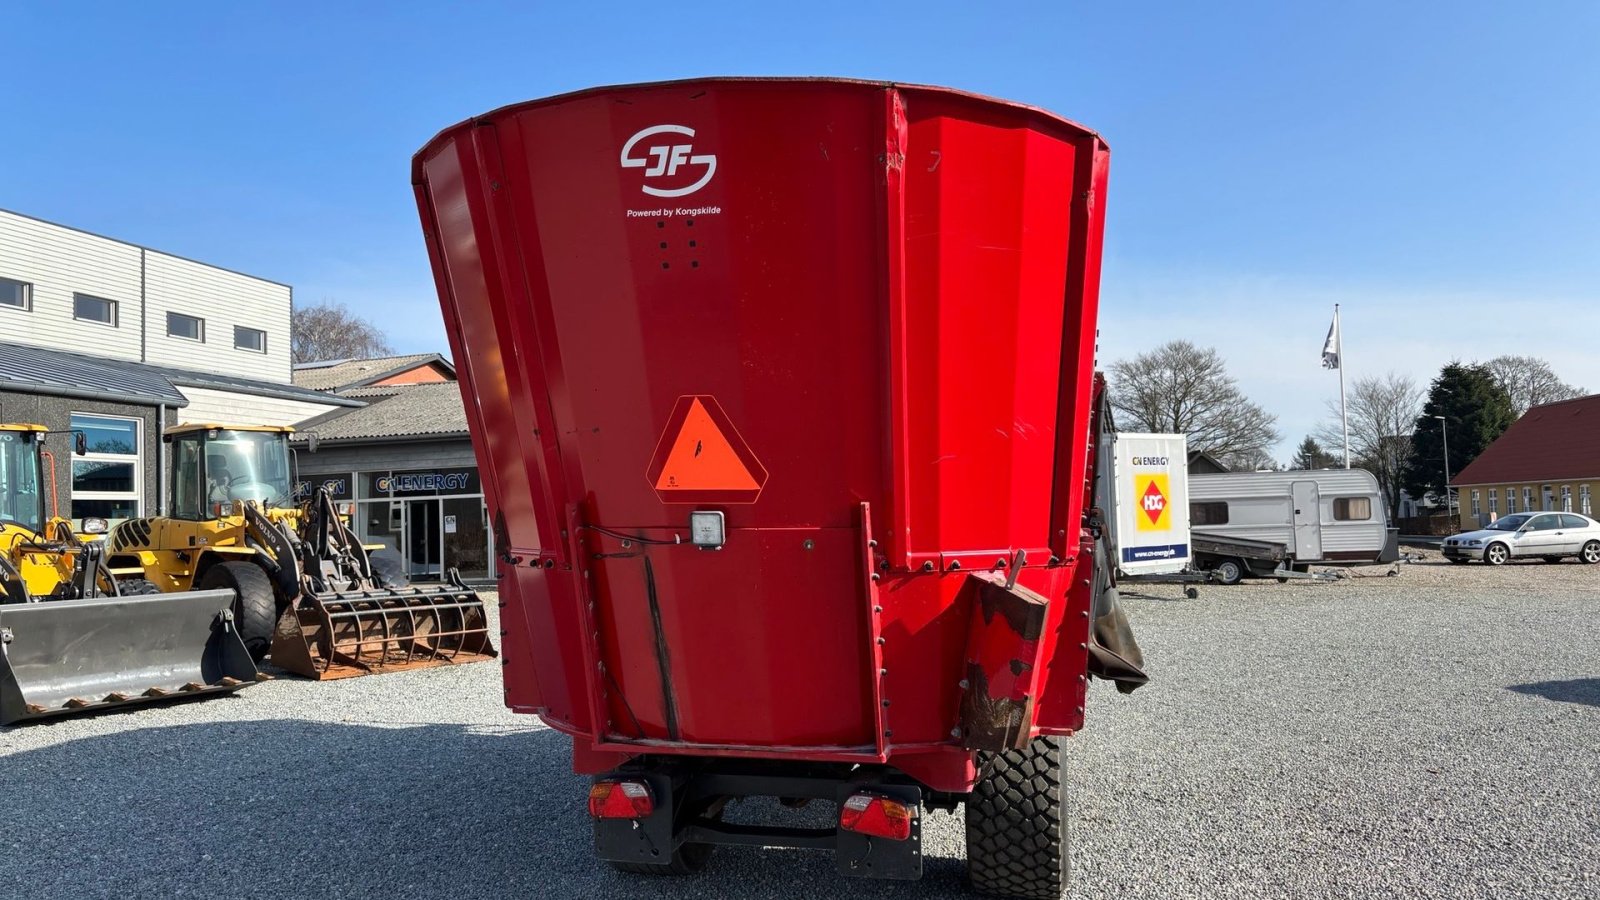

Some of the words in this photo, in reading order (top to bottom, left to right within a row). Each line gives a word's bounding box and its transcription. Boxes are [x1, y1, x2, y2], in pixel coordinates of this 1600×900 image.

[645, 144, 692, 177] JF
[627, 208, 662, 217] Powered
[663, 207, 673, 217] by
[675, 206, 721, 216] Kongskilde
[1143, 456, 1169, 466] ENERGY
[400, 473, 469, 491] ENERGY
[1143, 494, 1163, 511] HDG
[255, 516, 277, 543] VOLVO
